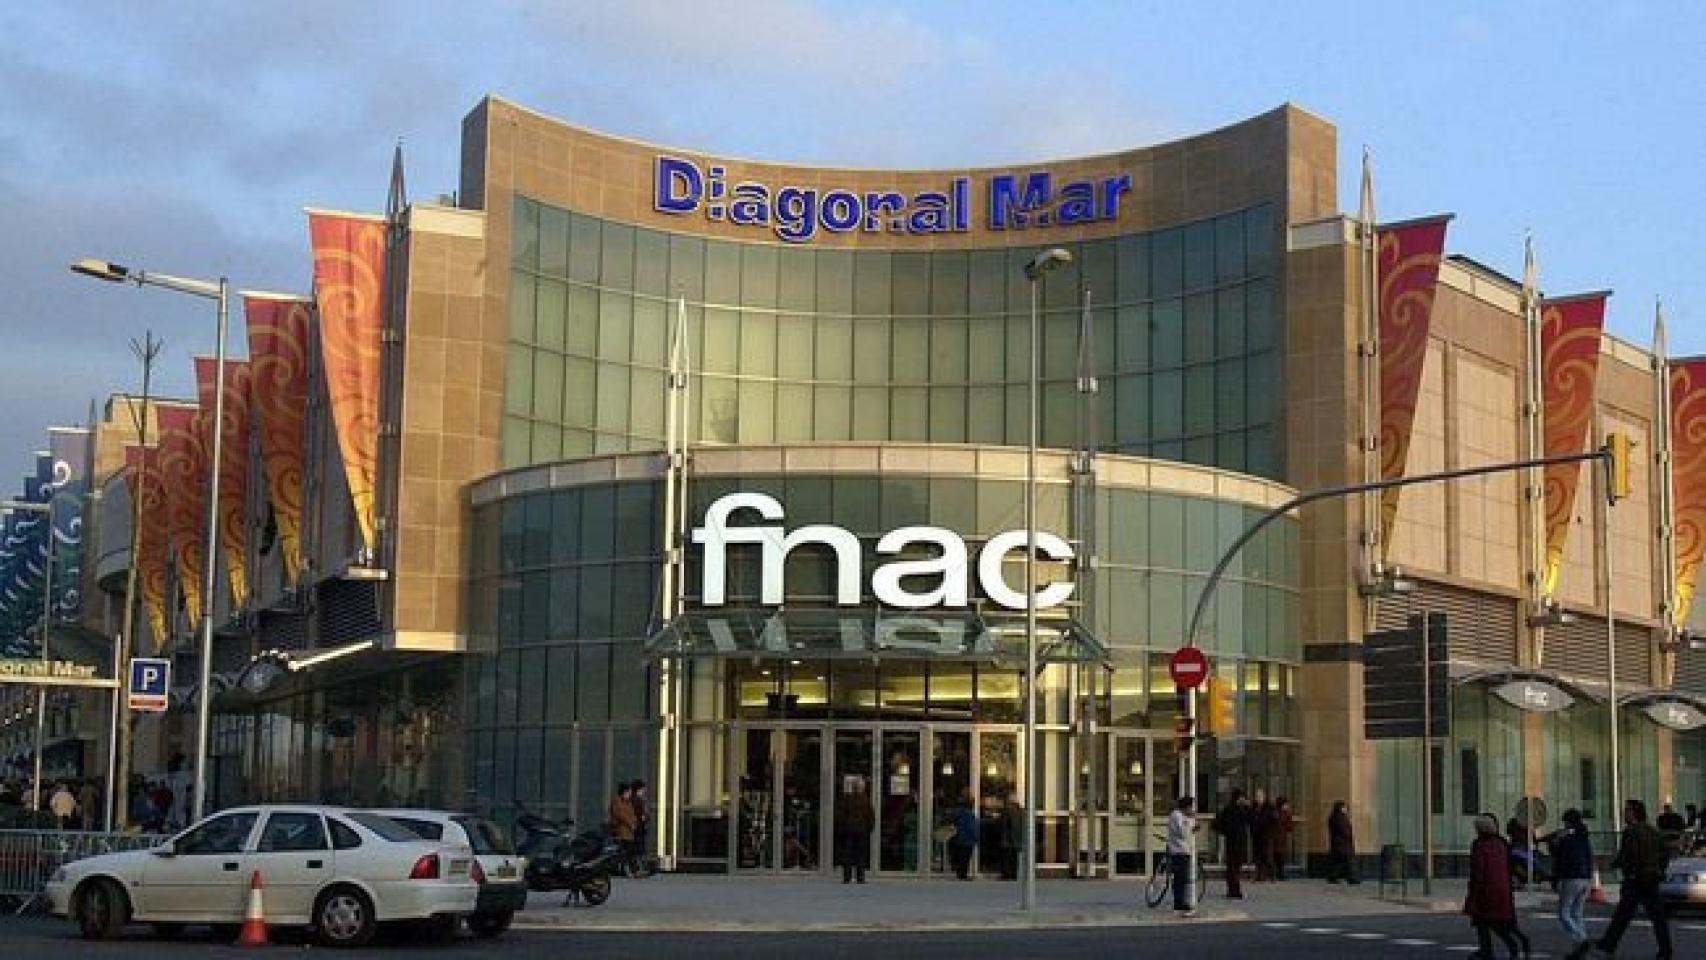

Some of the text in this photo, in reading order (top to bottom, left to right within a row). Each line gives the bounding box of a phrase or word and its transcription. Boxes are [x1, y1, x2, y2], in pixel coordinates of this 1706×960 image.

[655, 154, 1133, 242] Diagonal Mar
[692, 492, 1075, 608] fnac
[0, 660, 96, 678] onal Mar
[142, 666, 159, 691] P
